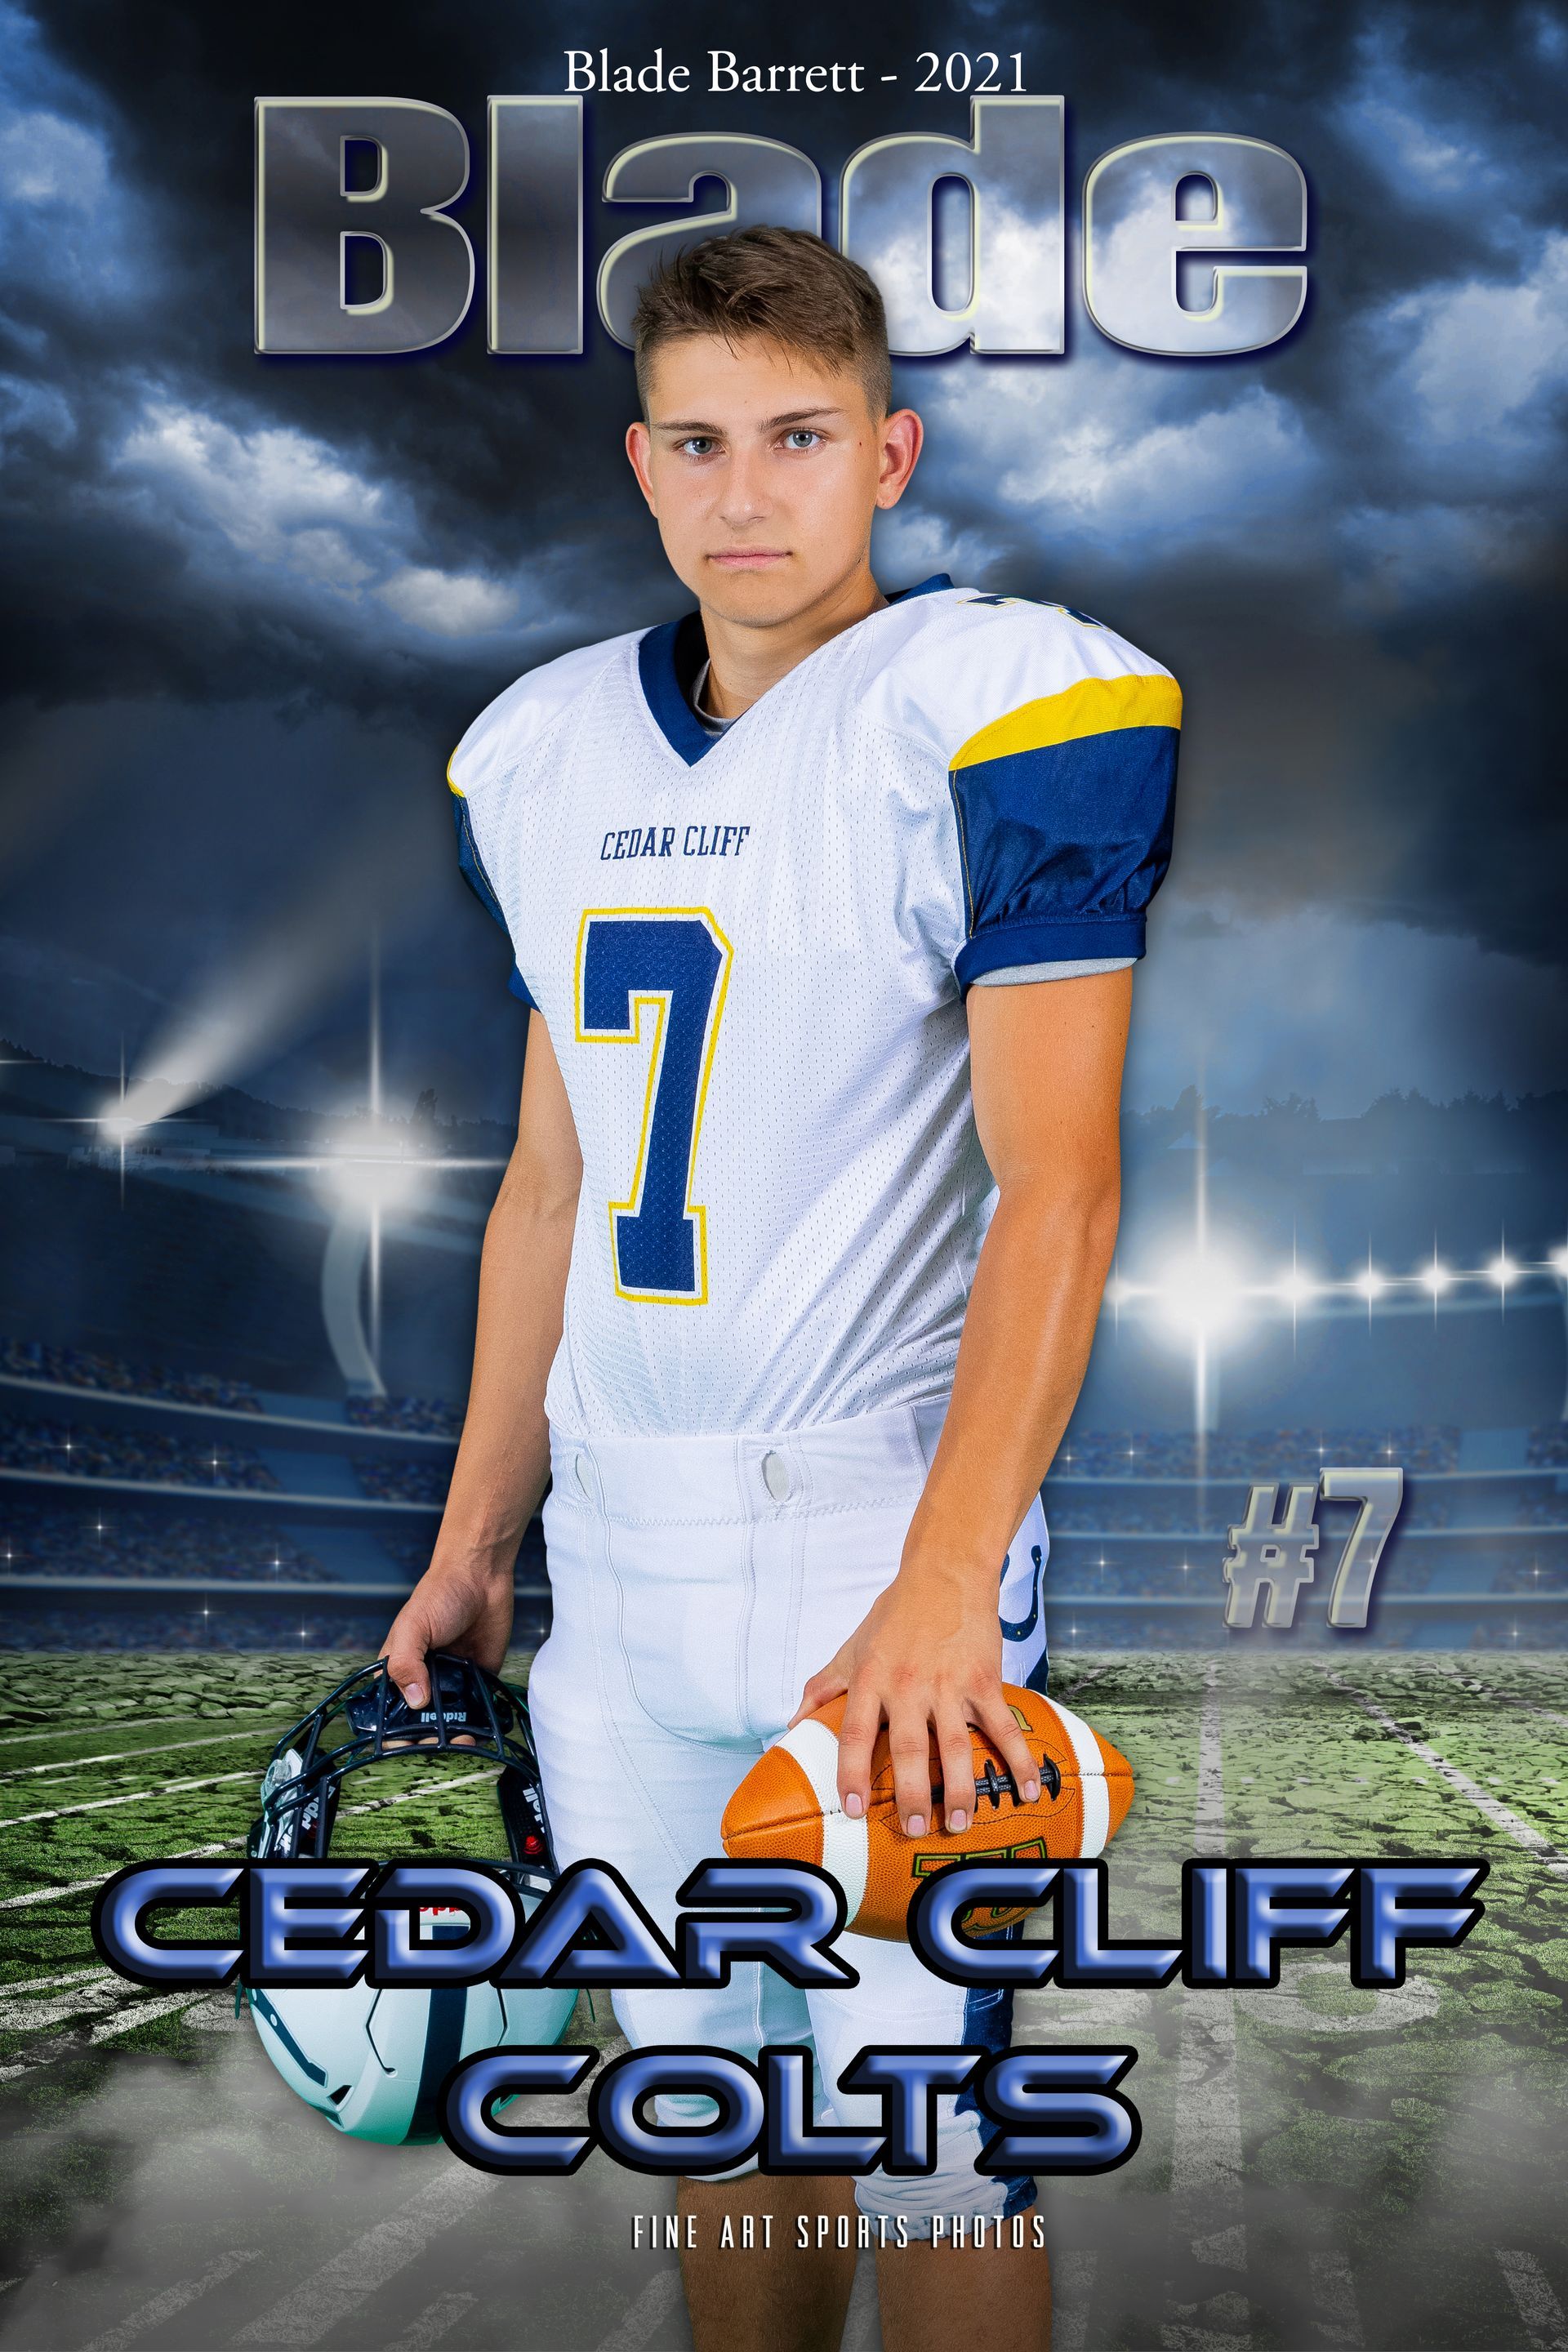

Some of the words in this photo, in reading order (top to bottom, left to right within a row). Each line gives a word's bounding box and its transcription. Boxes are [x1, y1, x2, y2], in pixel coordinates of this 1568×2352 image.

[600, 826, 675, 860] CEDAR
[683, 825, 751, 856] CLIFF
[575, 906, 734, 1306] 7
